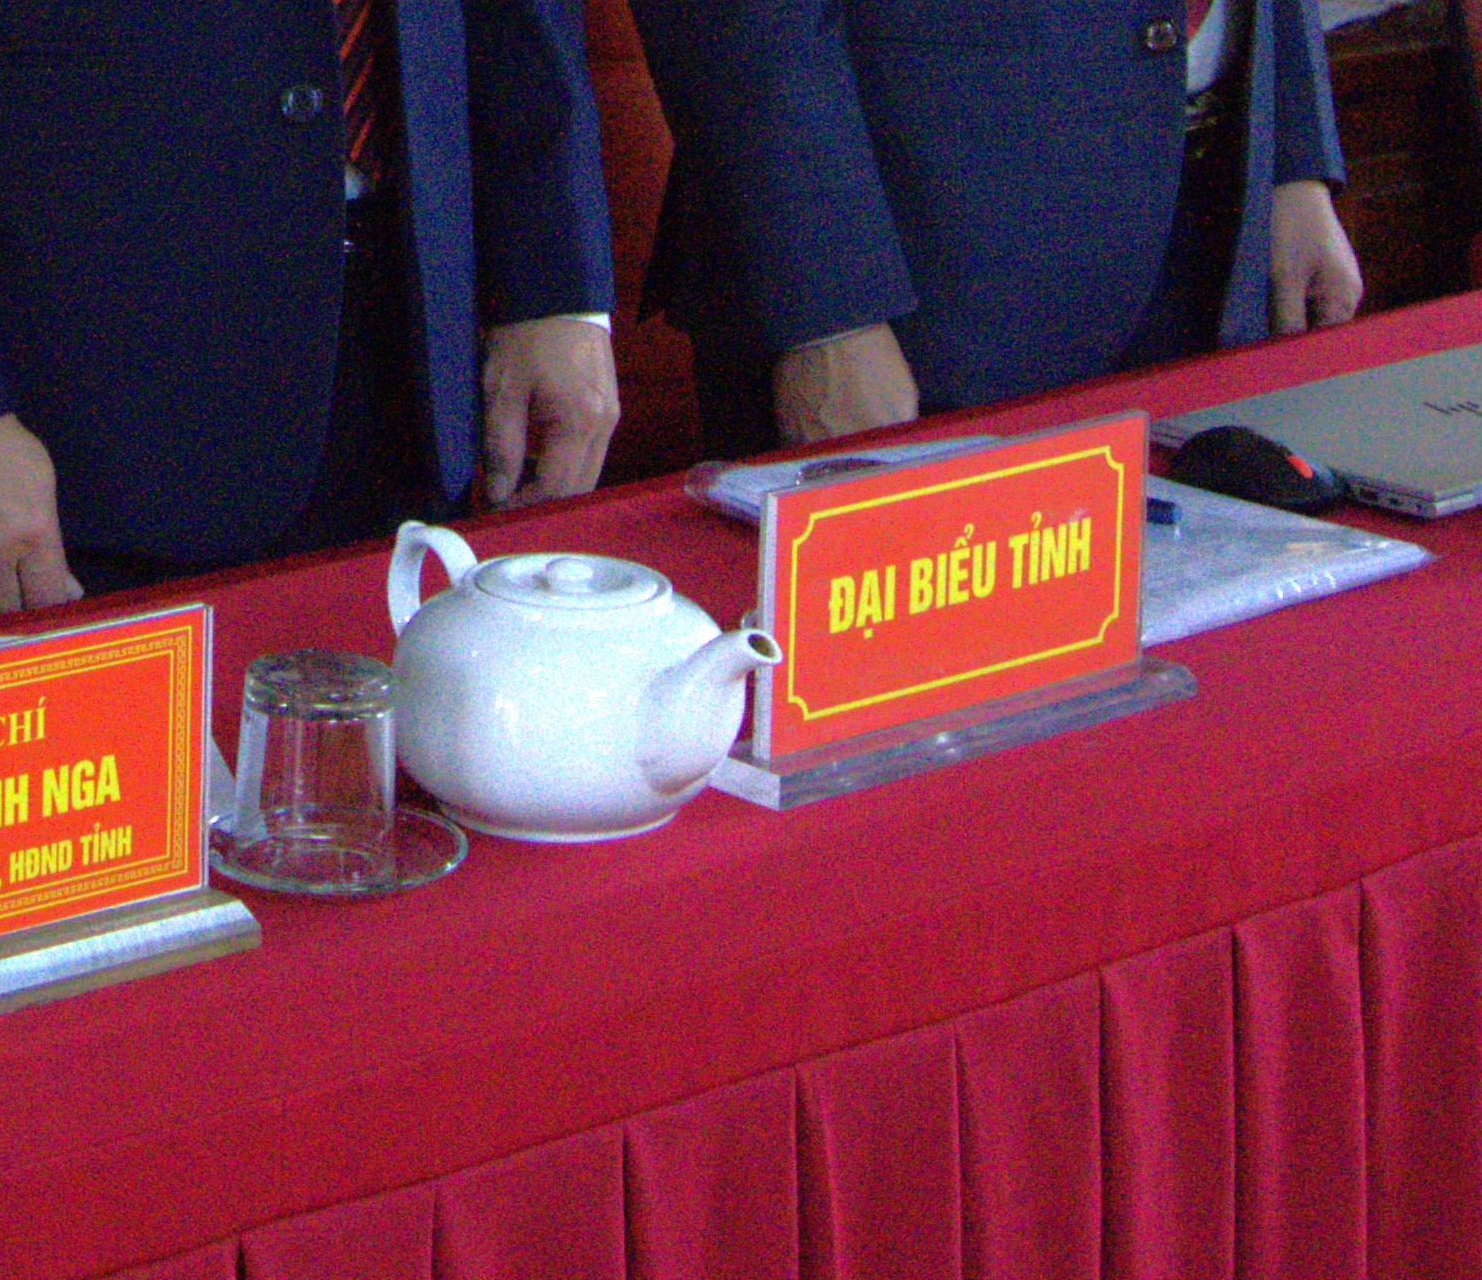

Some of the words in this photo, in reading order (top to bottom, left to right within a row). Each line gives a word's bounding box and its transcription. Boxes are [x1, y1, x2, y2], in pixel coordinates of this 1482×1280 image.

[829, 566, 896, 639] ĐẠI
[909, 524, 997, 615] BIỂU
[1009, 511, 1092, 589] TỈNH
[42, 754, 121, 818] NGA
[9, 839, 74, 885] HĐND
[80, 821, 133, 866] TỈNH
